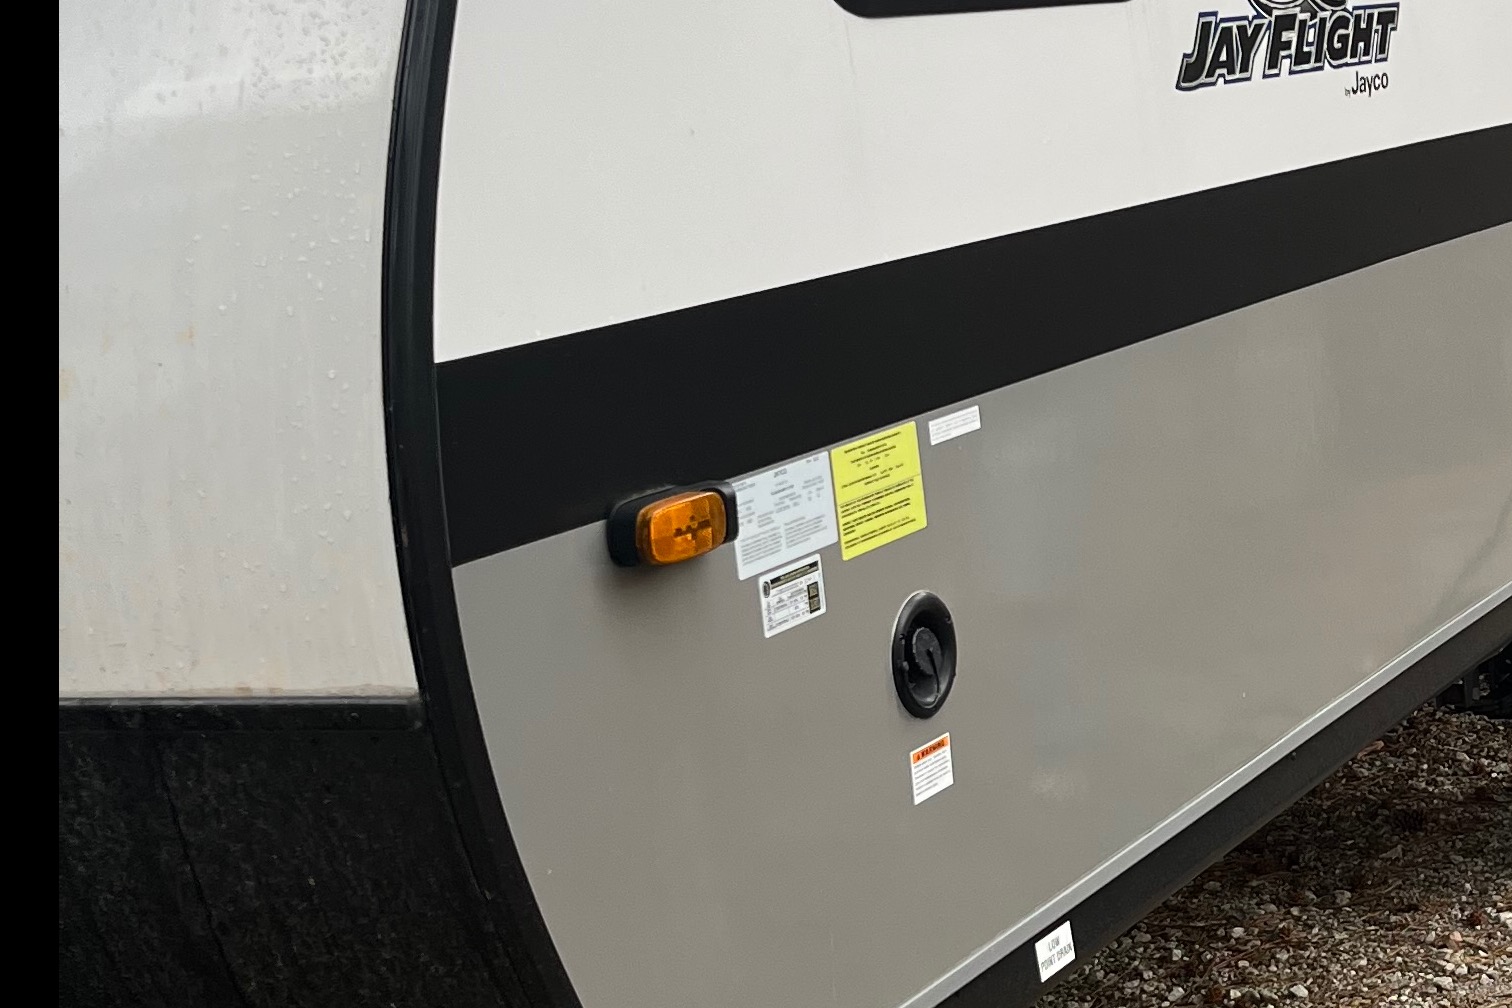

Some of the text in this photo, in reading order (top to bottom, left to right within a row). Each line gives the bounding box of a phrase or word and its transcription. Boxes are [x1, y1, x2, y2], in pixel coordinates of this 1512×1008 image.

[1176, 2, 1399, 91] JAY FLIGHT
[1351, 70, 1389, 98] Jayco
[1040, 941, 1073, 973] POINT DRAIN
[1047, 935, 1060, 952] LOW
